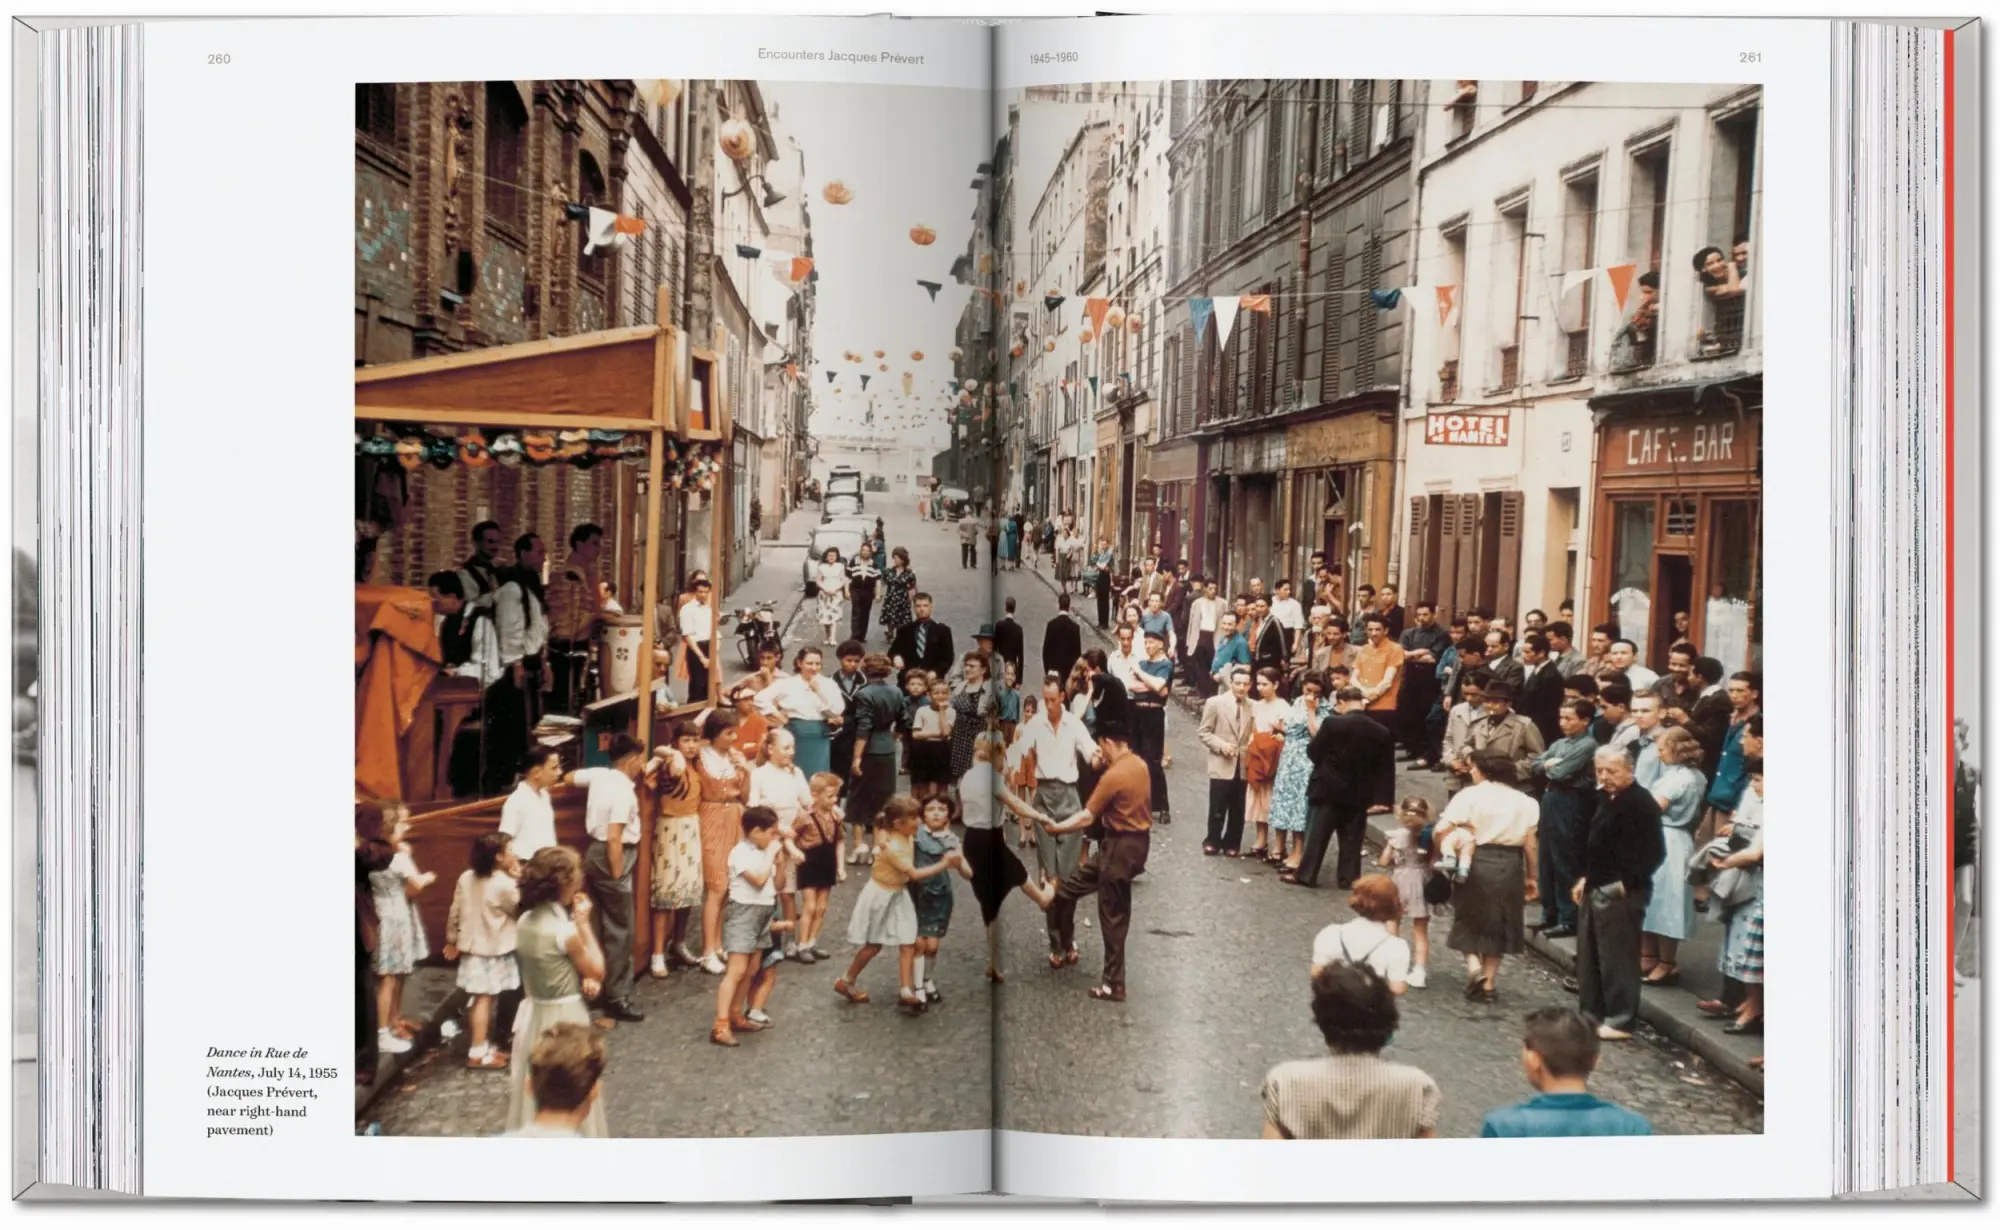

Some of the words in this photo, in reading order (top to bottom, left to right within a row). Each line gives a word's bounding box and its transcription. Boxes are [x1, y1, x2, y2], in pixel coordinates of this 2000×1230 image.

[207, 53, 231, 65] 260
[758, 48, 825, 60] Encounters
[828, 50, 878, 63] Jacques
[880, 51, 925, 65] Prévert
[1739, 51, 1762, 63] 261
[1428, 415, 1507, 439] HOTEL
[1692, 421, 1735, 462] BAR
[206, 1046, 247, 1059] Dance
[249, 1046, 262, 1059] in
[264, 1046, 290, 1059] Rue
[292, 1046, 309, 1059] de
[206, 1066, 255, 1080] Nantes,
[257, 1066, 285, 1081] July
[287, 1067, 306, 1080] 14,
[308, 1067, 338, 1079] 1955
[206, 1085, 264, 1100] (Jacques
[266, 1086, 319, 1100] Prévert,
[206, 1107, 237, 1117] near
[239, 1105, 308, 1120] right-hand
[206, 1124, 274, 1138] pavement)
